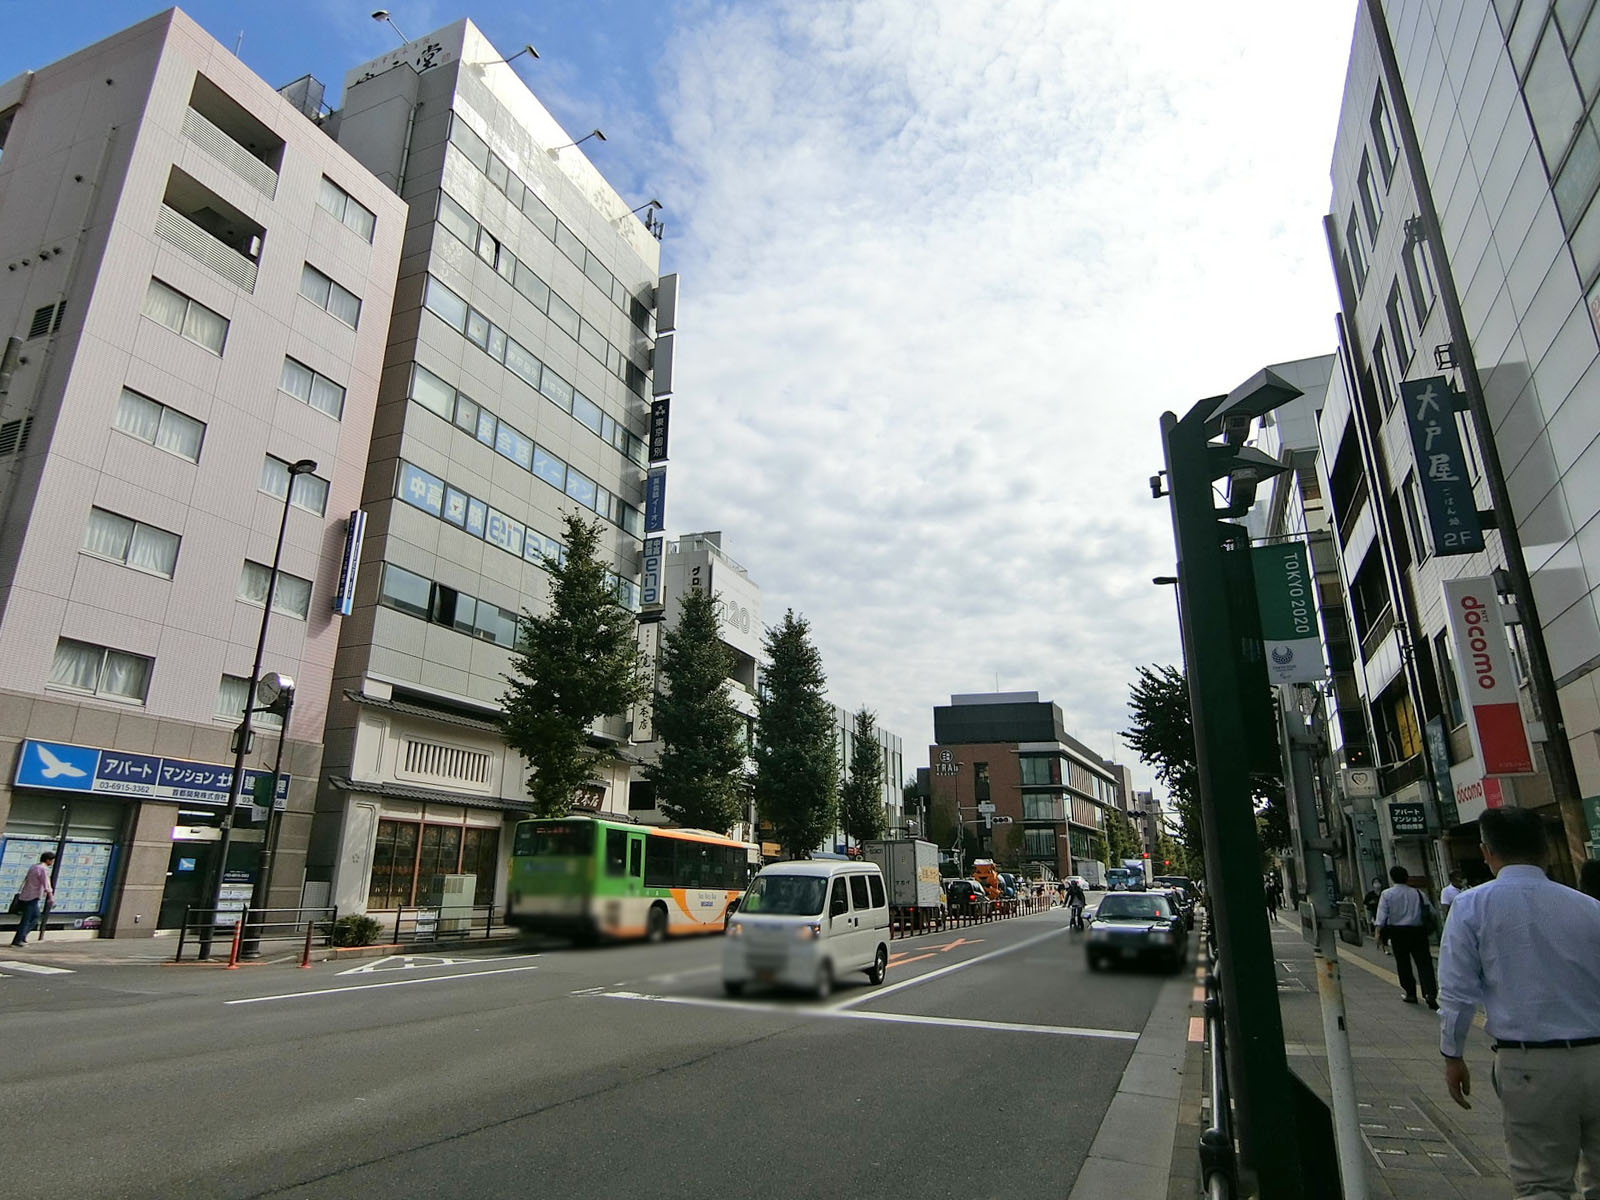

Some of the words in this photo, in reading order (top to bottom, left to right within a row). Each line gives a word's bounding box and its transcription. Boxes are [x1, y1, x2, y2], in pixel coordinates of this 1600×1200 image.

[1416, 384, 1460, 482] 大戸屋
[1444, 531, 1472, 547] 2F
[644, 558, 658, 602] ena
[1284, 553, 1304, 597] TOKYO
[1291, 600, 1310, 633] 2020
[1461, 596, 1496, 689] docomo
[104, 759, 152, 778] アパート
[163, 766, 214, 785] マンション
[1456, 782, 1482, 803] docomo
